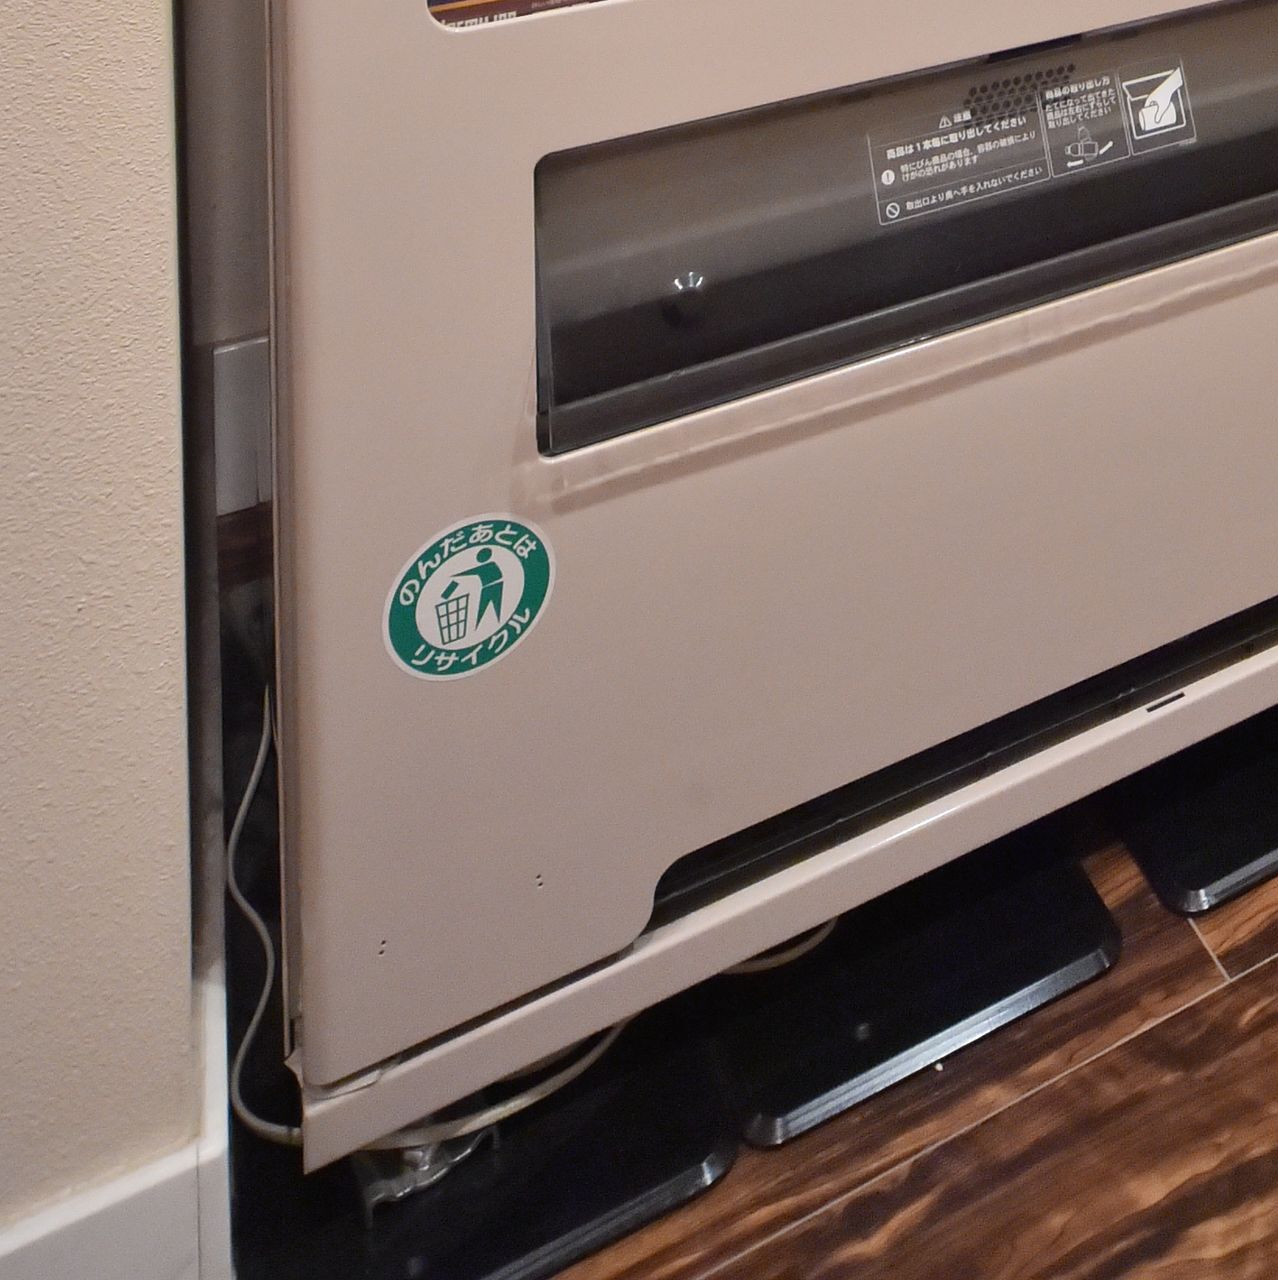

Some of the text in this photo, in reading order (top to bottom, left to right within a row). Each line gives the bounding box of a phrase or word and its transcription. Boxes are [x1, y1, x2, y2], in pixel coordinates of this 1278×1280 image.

[399, 523, 538, 606] のんだあとは
[411, 607, 531, 672] リサイクル
